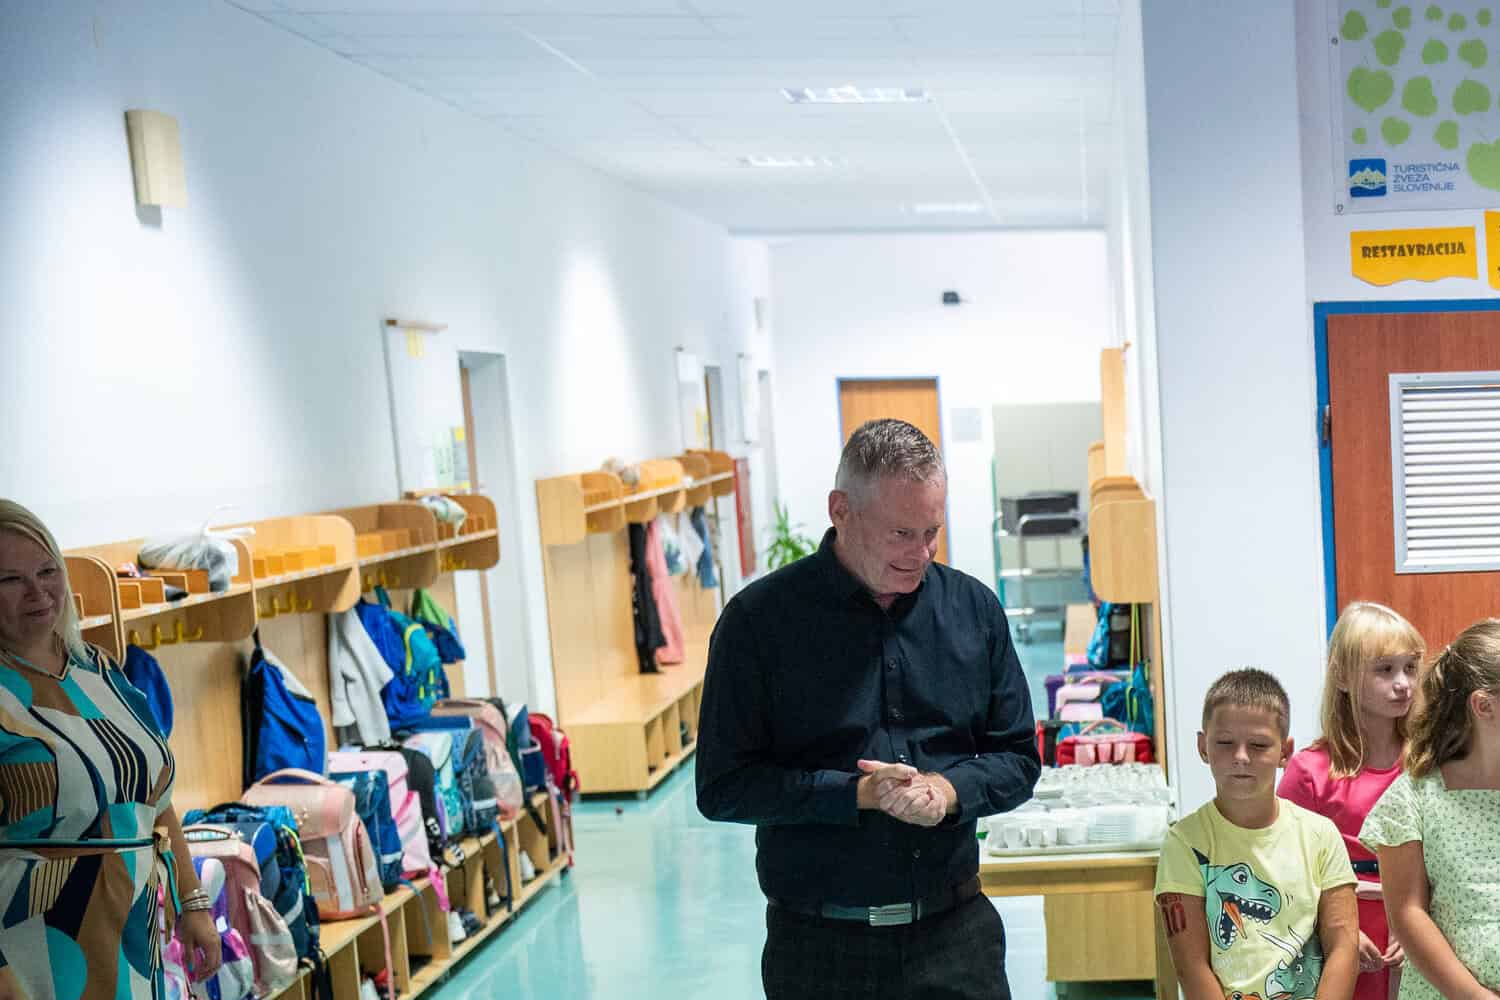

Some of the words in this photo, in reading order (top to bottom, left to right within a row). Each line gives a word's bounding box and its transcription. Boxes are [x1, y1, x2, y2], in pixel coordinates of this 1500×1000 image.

[1392, 162, 1460, 174] TURISTIČNA
[1392, 174, 1431, 183] ZVEZA
[1392, 182, 1456, 192] SLOVENIJE
[1361, 241, 1467, 259] RESTAVRACIJA
